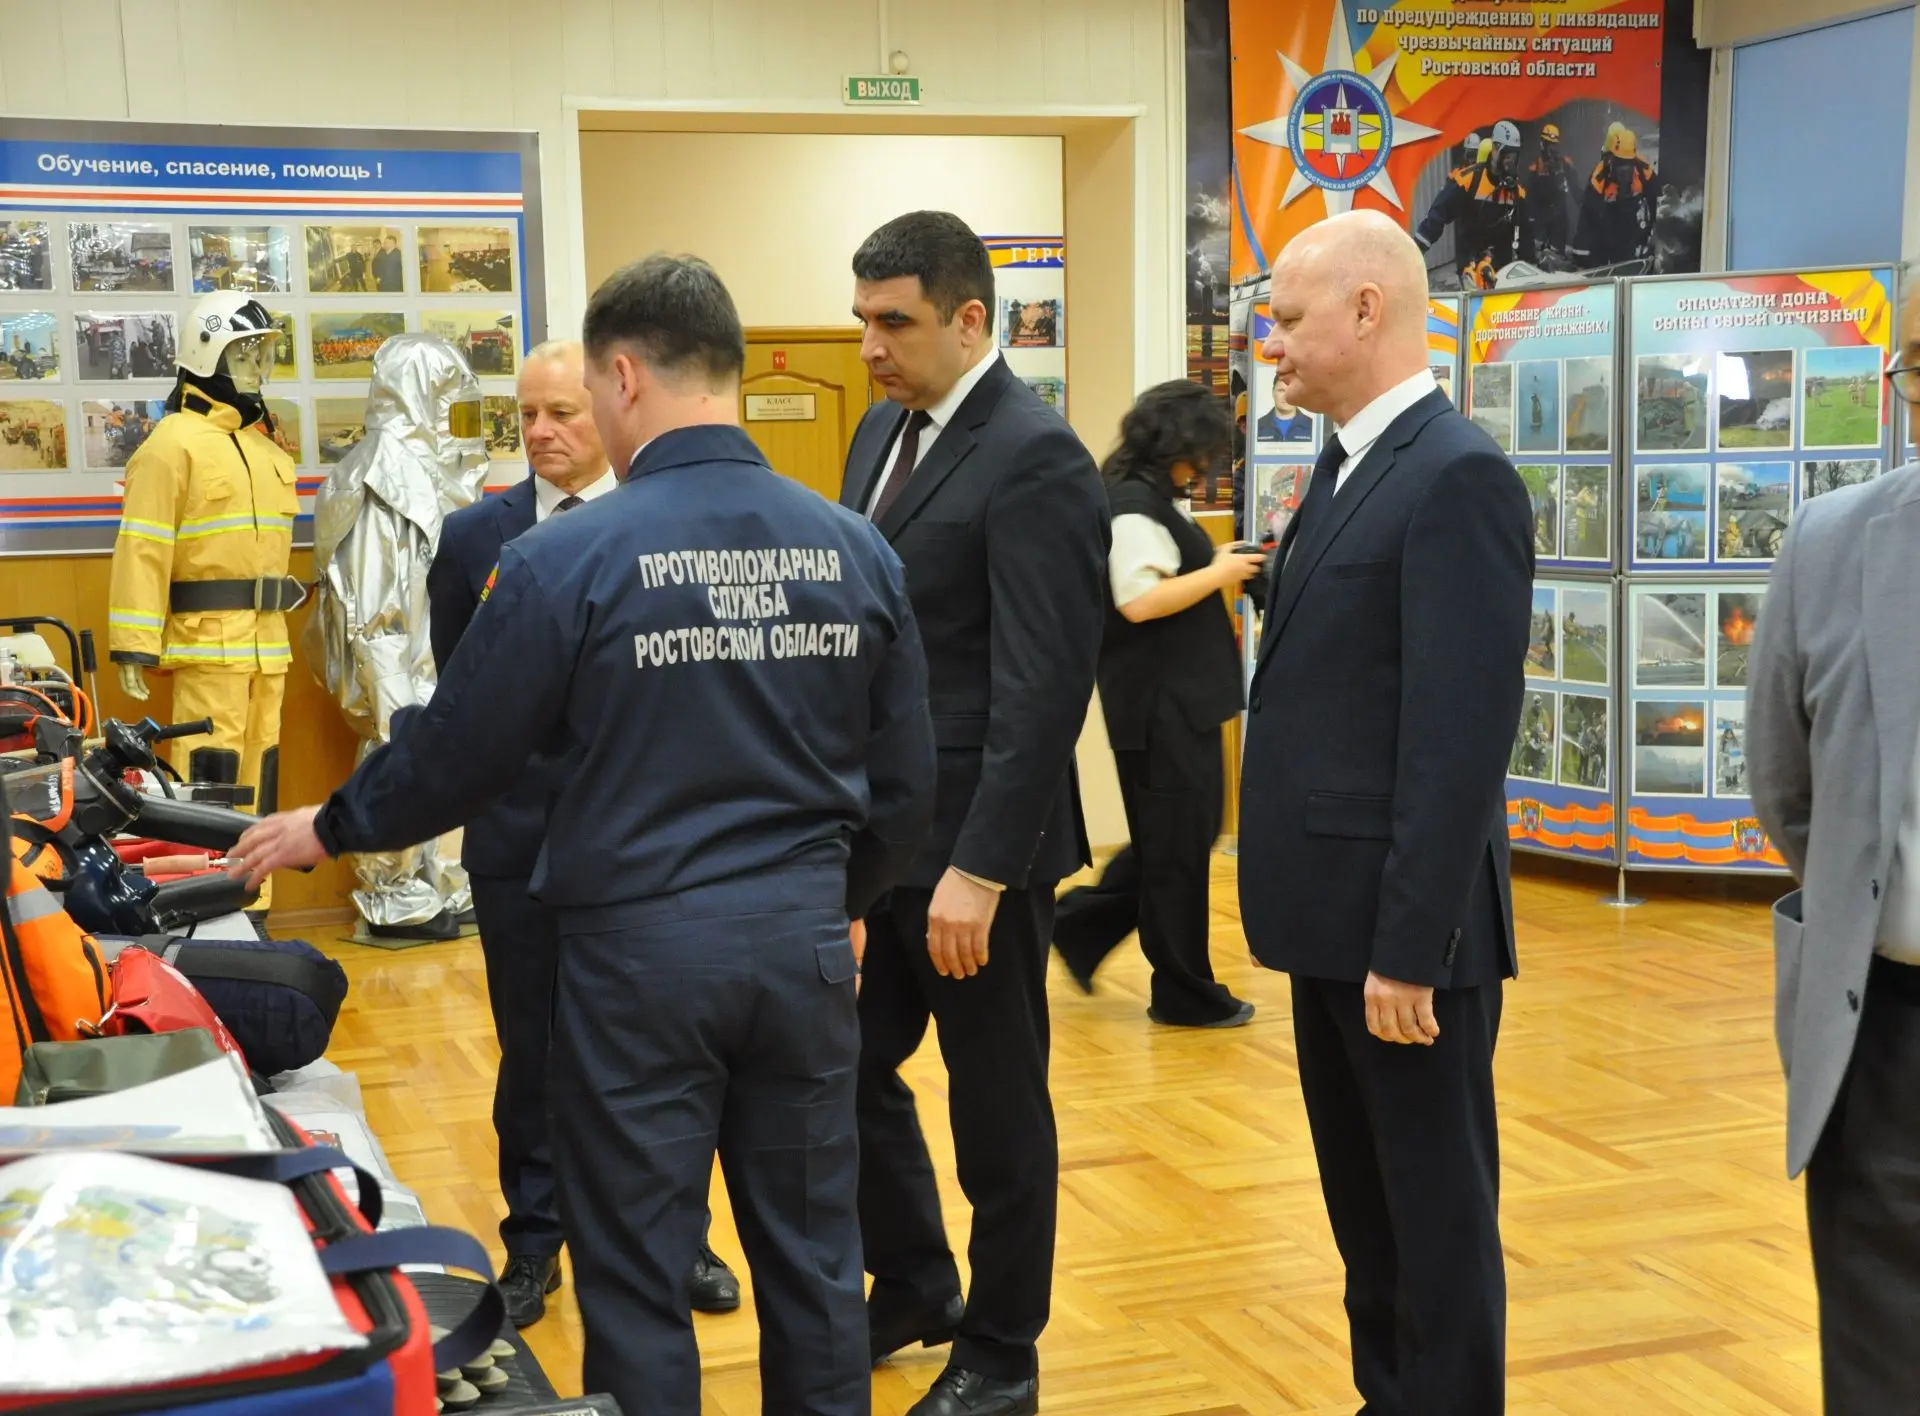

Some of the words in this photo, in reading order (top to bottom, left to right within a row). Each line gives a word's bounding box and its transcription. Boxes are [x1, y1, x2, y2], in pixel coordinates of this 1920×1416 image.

[1356, 9, 1379, 23] по
[1383, 10, 1534, 28] предупреждению
[1539, 13, 1550, 27] и
[1555, 12, 1659, 28] ликвидации
[1398, 34, 1526, 53] чрезвычайных
[1531, 34, 1613, 54] ситуаций
[1420, 58, 1521, 76] Ростовской
[1526, 59, 1596, 77] области
[857, 80, 912, 100] ВЫХОД
[38, 154, 159, 177] Обучение,
[165, 161, 276, 180] спасение,
[283, 164, 370, 180] помощь
[1677, 294, 1777, 312] СПАСАТЕЛИ
[1781, 292, 1829, 308] ДОНА
[1490, 308, 1541, 324] СПАСЕНИЕ
[1546, 304, 1584, 320] ЖИЗНИ
[1654, 316, 1708, 331] СЫНЫ
[1713, 310, 1770, 327] СВОЕЙ
[1774, 307, 1867, 325] ОТЧИЗНЫ!
[1475, 325, 1543, 343] ДОСТОИНСТВО
[638, 549, 842, 589] ПРОТИВОПОЖАРНАЯ
[708, 583, 790, 620] СЛУЖБА
[634, 620, 765, 669] РОСТОВСКОЙ
[770, 623, 859, 659] ОБЛАСТИ
